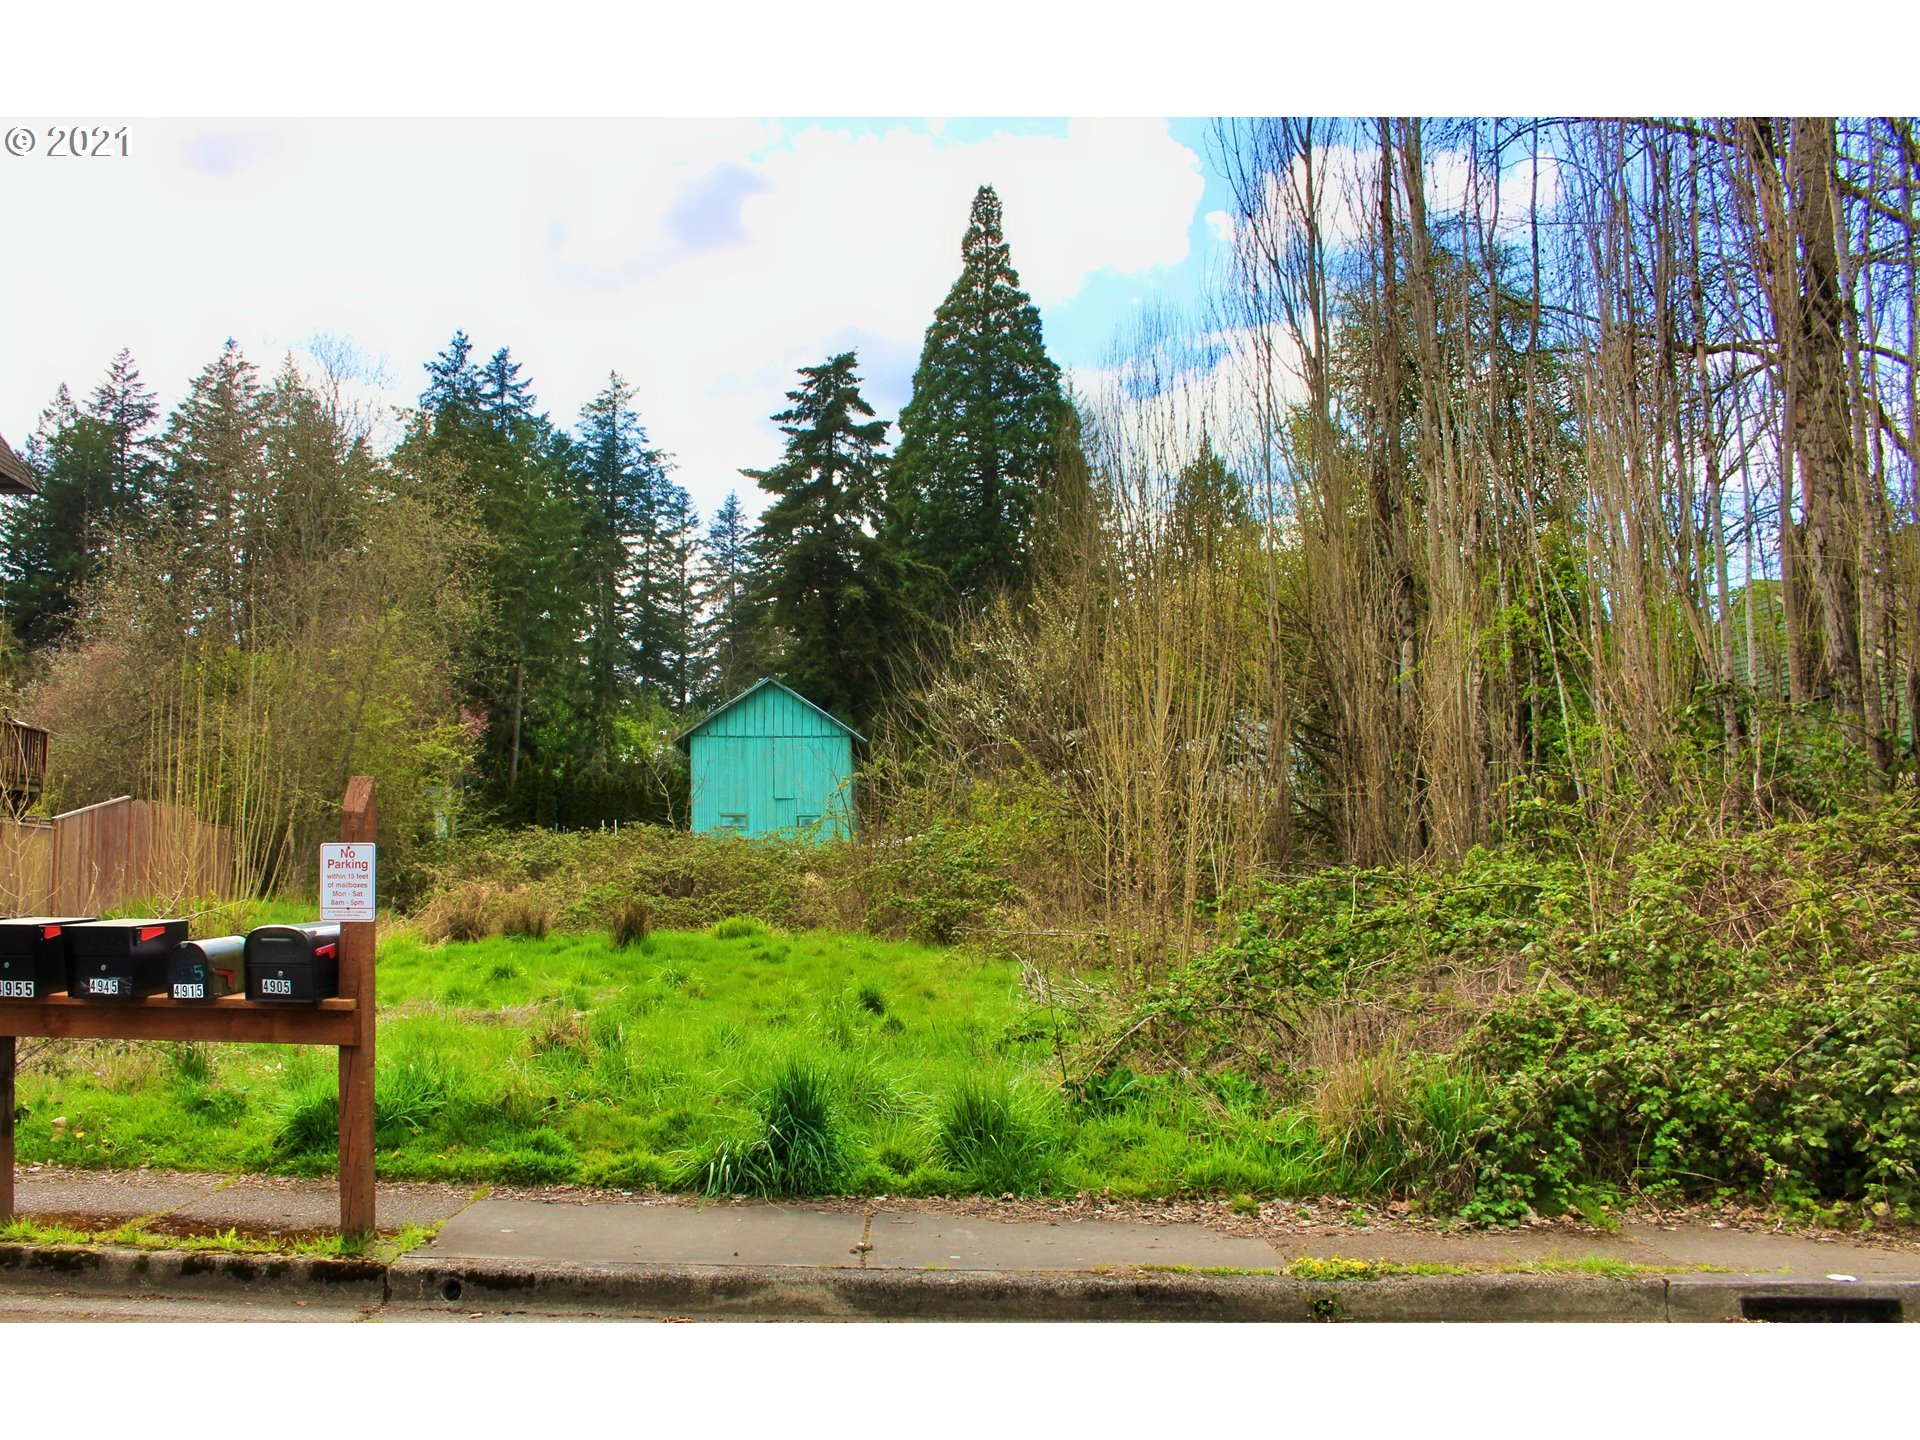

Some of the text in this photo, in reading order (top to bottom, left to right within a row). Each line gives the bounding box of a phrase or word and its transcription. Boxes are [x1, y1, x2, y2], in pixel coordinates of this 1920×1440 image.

[340, 848, 356, 858] No
[327, 859, 369, 872] Parking
[350, 899, 365, 907] 5pm
[90, 979, 118, 994] 4945
[174, 984, 203, 998] 4915
[262, 979, 291, 994] 4905
